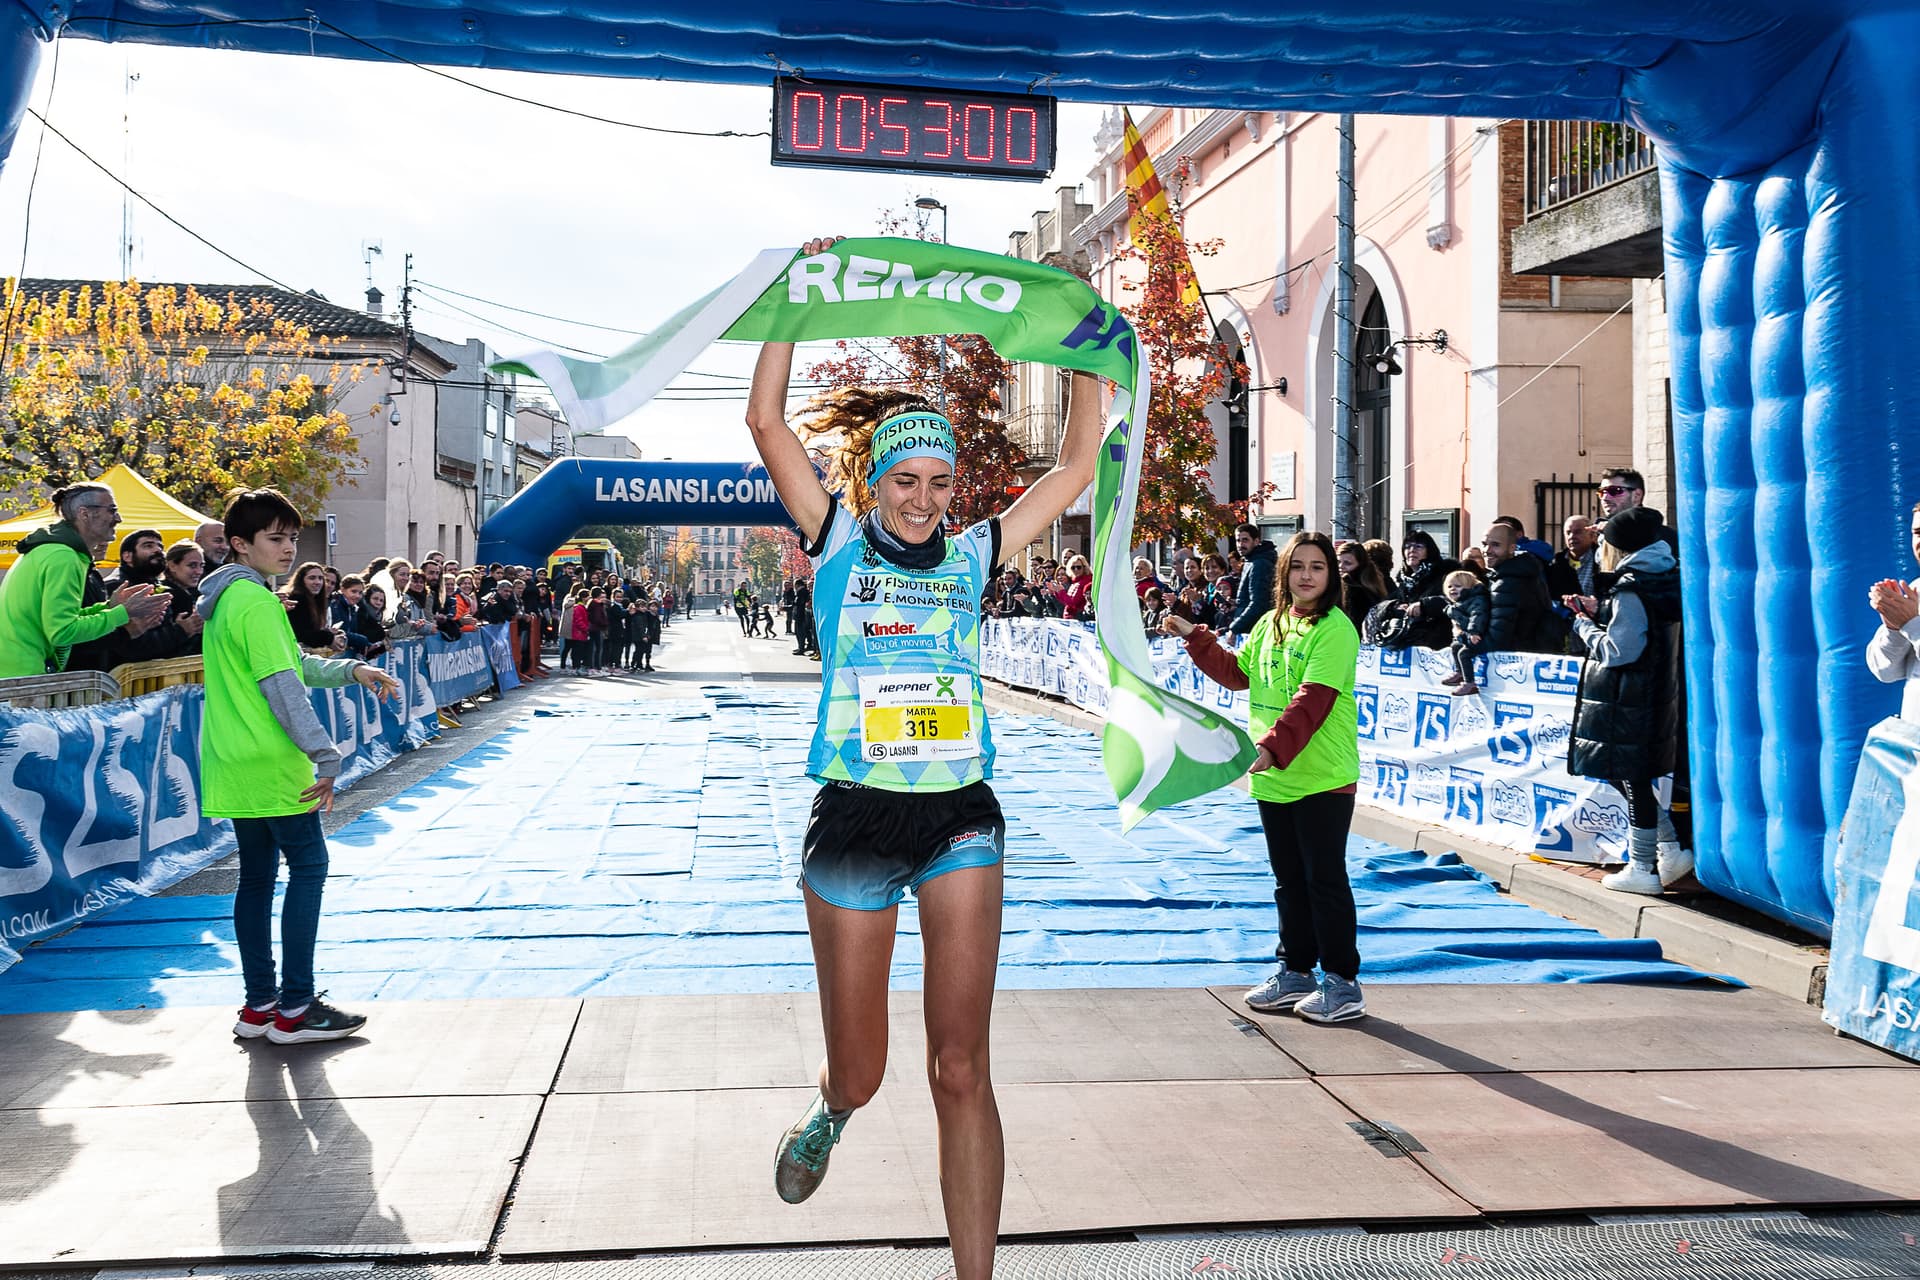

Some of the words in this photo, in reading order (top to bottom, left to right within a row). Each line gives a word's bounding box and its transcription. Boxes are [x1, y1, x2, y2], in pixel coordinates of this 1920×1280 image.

[792, 91, 1037, 165] 00:53:00
[776, 252, 1022, 313] REMIO
[595, 477, 776, 504] LASANSI.COM
[885, 577, 967, 596] FISIOTERAPIA
[883, 592, 973, 613] E.MONASTERIO
[888, 639, 898, 648] of
[901, 639, 934, 648] moving
[906, 708, 937, 716] MARTA
[905, 720, 938, 738] 315
[889, 745, 918, 757] LASANSI
